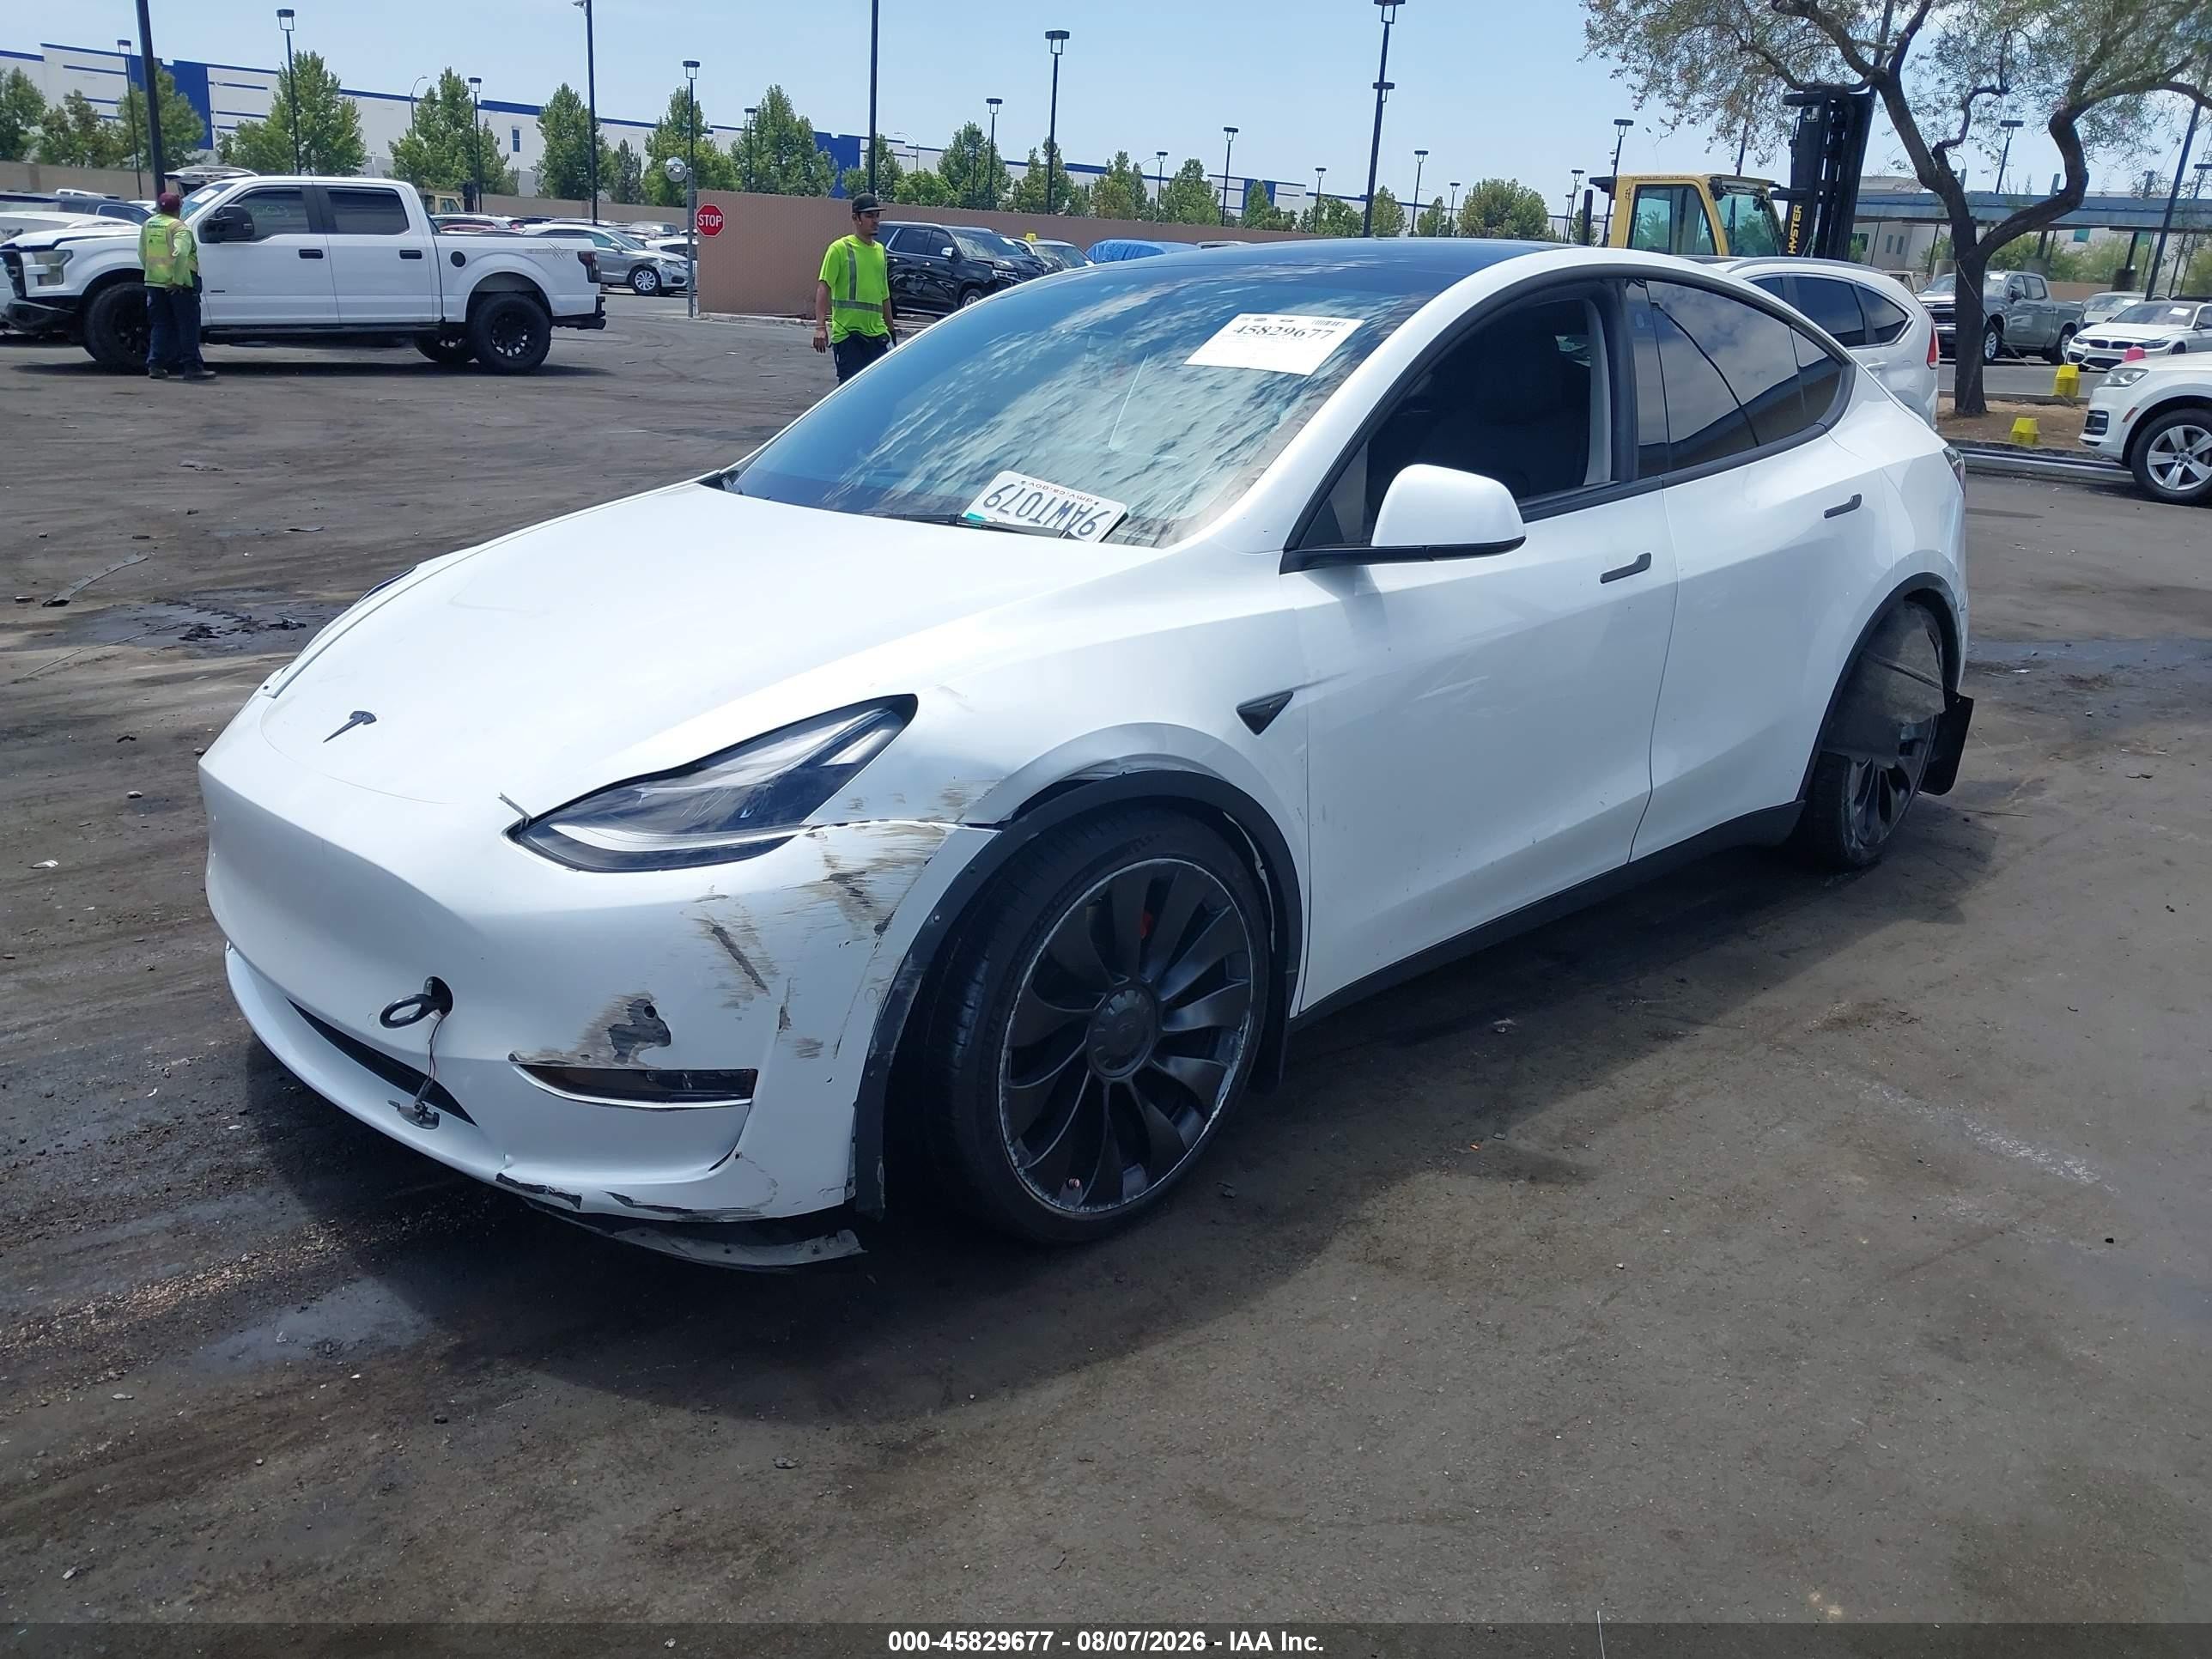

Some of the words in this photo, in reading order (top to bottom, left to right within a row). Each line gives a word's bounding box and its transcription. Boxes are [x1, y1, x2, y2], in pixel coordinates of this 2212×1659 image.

[697, 214, 722, 228] STOP
[1788, 204, 1802, 254] HYSTER
[1232, 325, 1336, 340] 45829677
[1029, 482, 1094, 503] dmv.ca.gov
[983, 483, 1111, 536] 9AWT079
